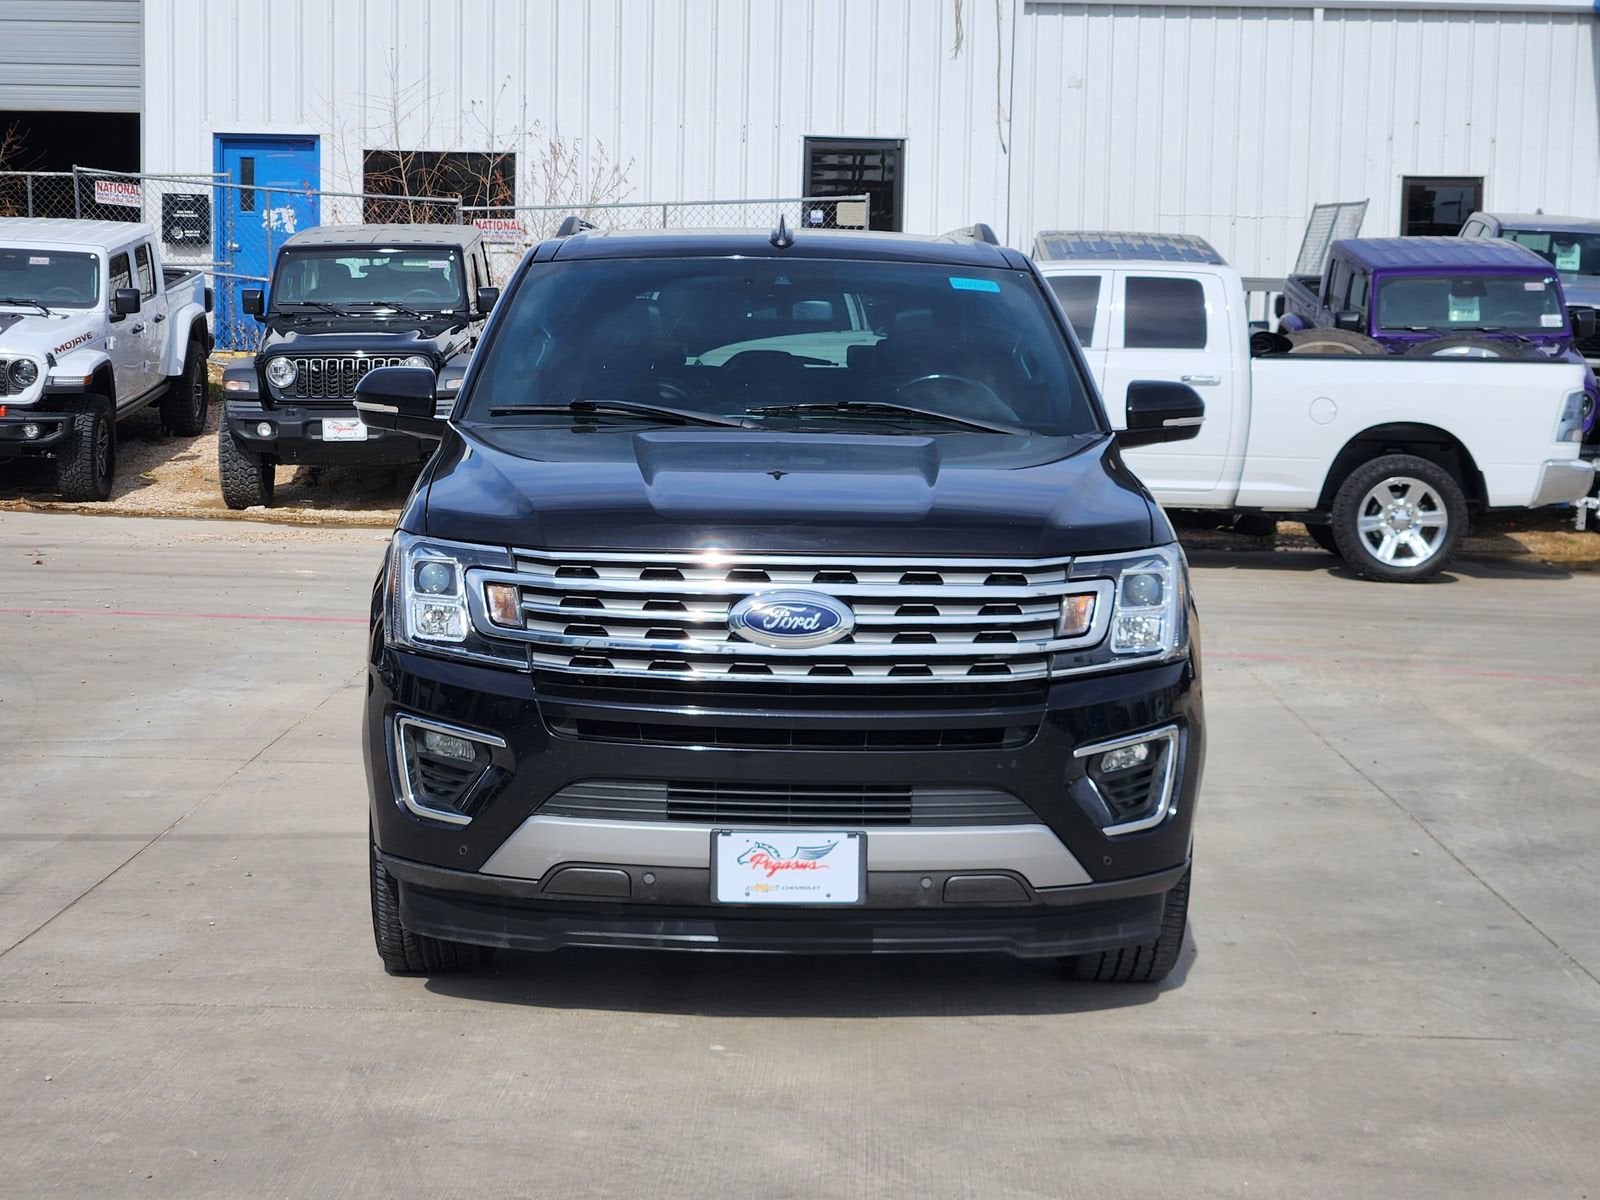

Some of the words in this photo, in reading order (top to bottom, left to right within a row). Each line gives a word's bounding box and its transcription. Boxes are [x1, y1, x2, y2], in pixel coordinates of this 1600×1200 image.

[96, 181, 141, 196] NATIONAL
[474, 220, 522, 231] NATIONAL
[54, 331, 93, 354] MOJAVE
[763, 605, 821, 630] Ford
[750, 853, 832, 878] Pegasus
